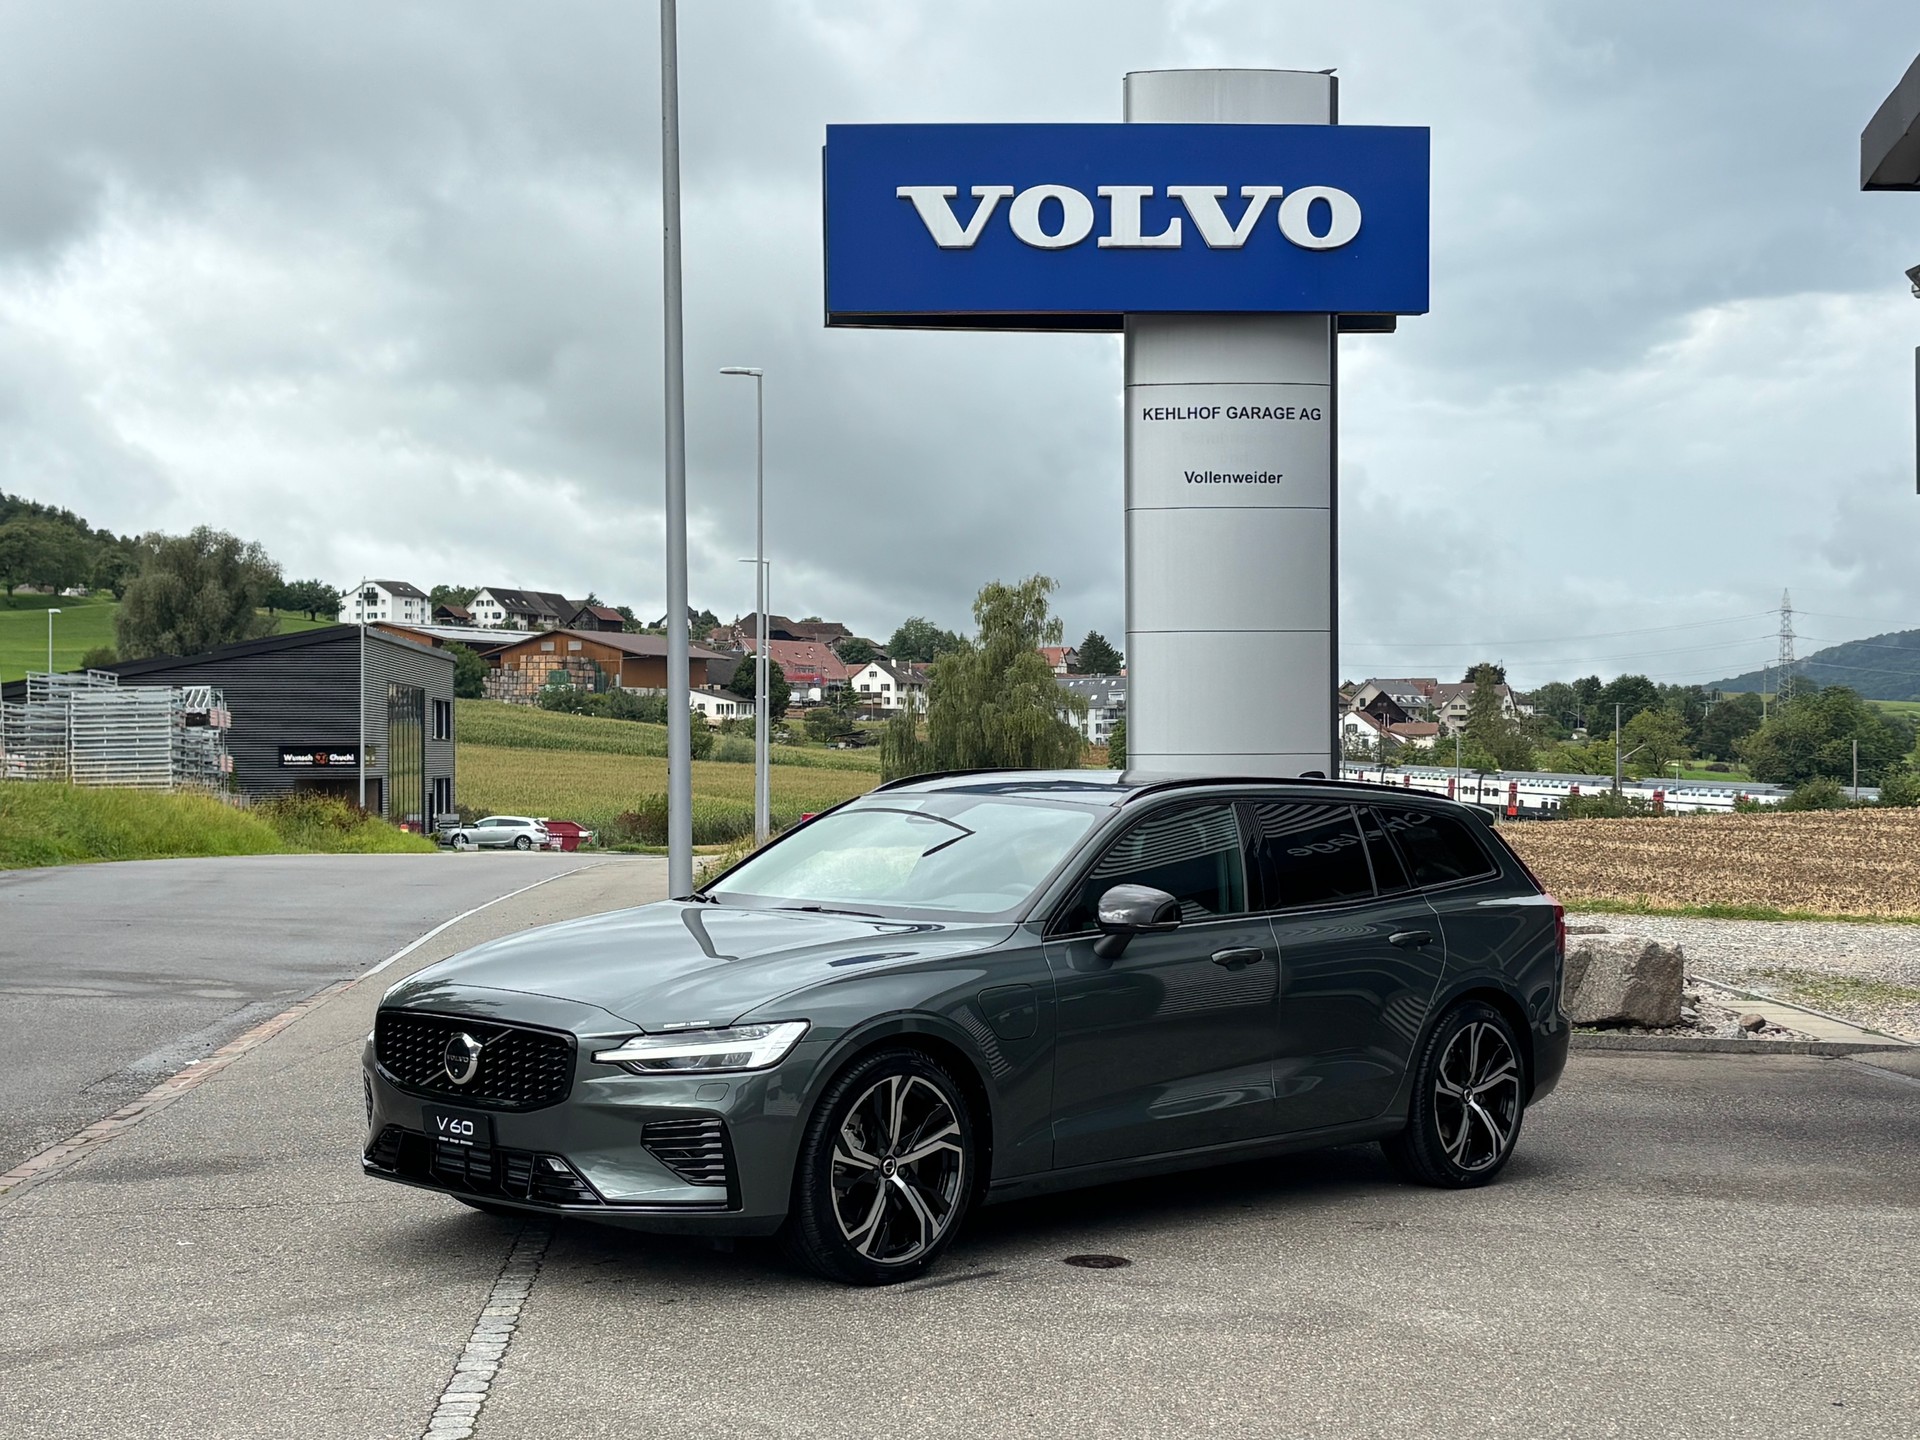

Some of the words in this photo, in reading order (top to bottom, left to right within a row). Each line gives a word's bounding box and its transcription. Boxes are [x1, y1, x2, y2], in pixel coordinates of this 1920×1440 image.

[896, 183, 1362, 250] VOLVO
[1142, 406, 1221, 421] KEHLHOF
[1226, 406, 1296, 420] GARAGE
[1299, 407, 1322, 421] AG
[1184, 470, 1283, 484] Vollenweider
[283, 753, 314, 762] Wunsch
[446, 1053, 470, 1063] VOLVO
[436, 1115, 474, 1136] V60
